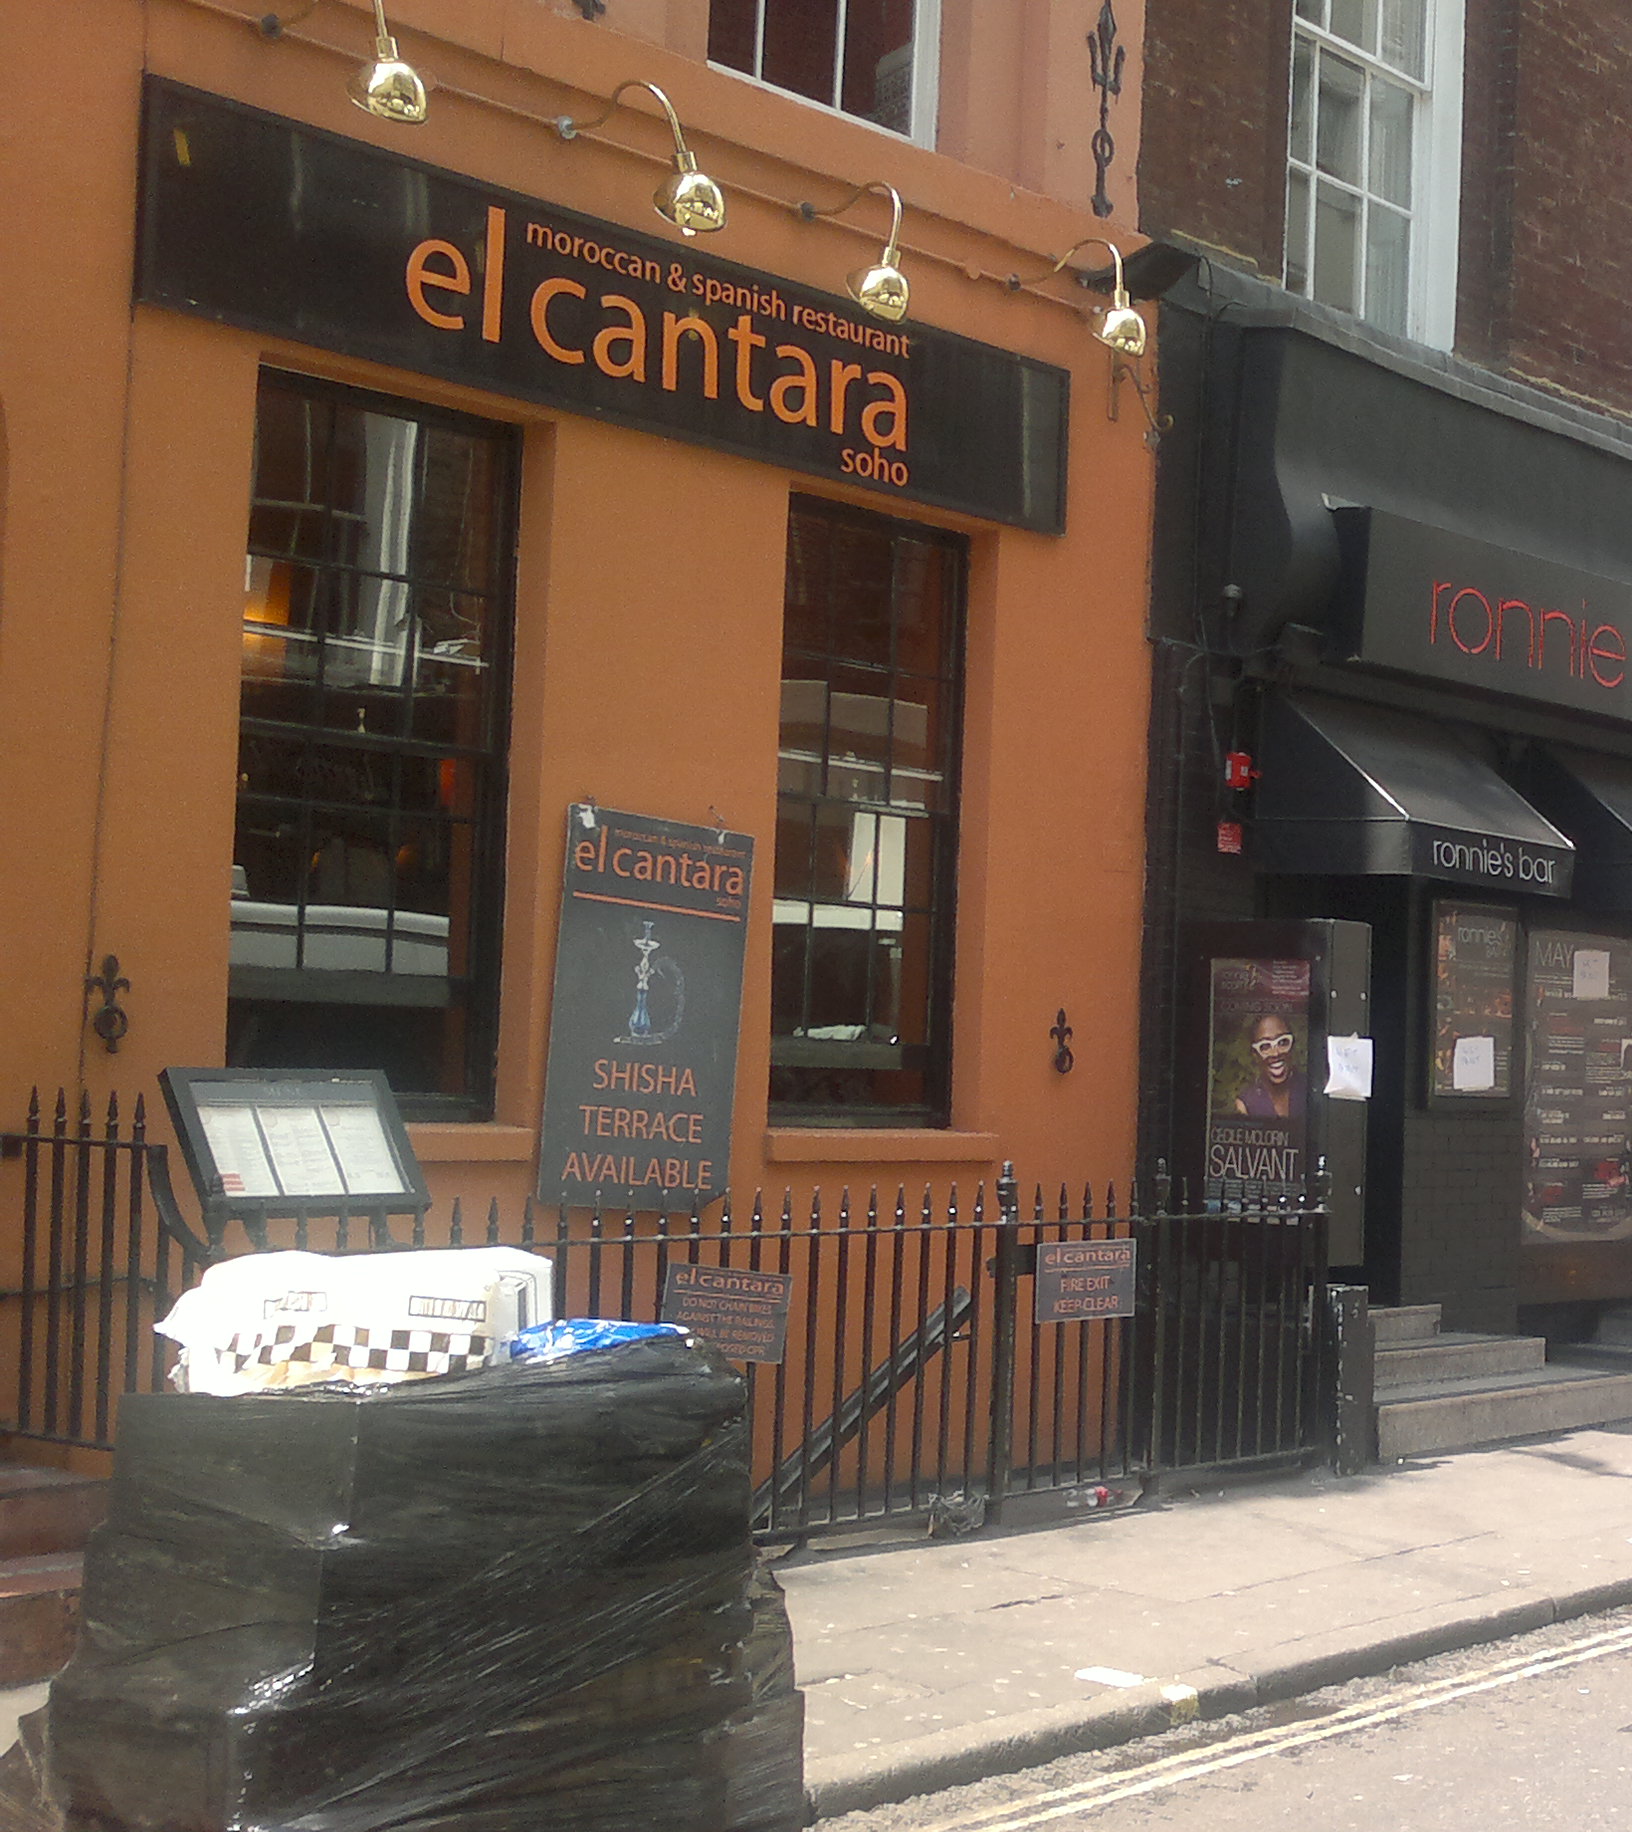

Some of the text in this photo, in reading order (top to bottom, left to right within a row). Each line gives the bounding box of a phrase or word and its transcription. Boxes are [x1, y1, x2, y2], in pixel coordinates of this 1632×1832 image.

[527, 222, 910, 359] moroccan & spanish restaurant
[406, 206, 907, 451] el cantara
[841, 448, 908, 486] soho
[1430, 579, 1626, 688] ronnie
[575, 824, 744, 896] el cantara
[1433, 838, 1556, 883] ronnie's bar
[1535, 940, 1575, 969] MAY
[593, 1058, 697, 1097] SHISHA
[579, 1104, 704, 1144] TERRACE
[561, 1151, 712, 1190] AVAILABLE
[1210, 1144, 1299, 1181] SALVANT
[1045, 1248, 1131, 1265] el cantara
[675, 1267, 697, 1285] el
[699, 1273, 785, 1294] cantara
[1060, 1275, 1111, 1292] FIRE EXIT
[677, 1311, 716, 1323] AGAINST
[682, 1297, 697, 1307] DO
[699, 1298, 717, 1309] NOT
[1053, 1295, 1119, 1313] KEEP CLEAR
